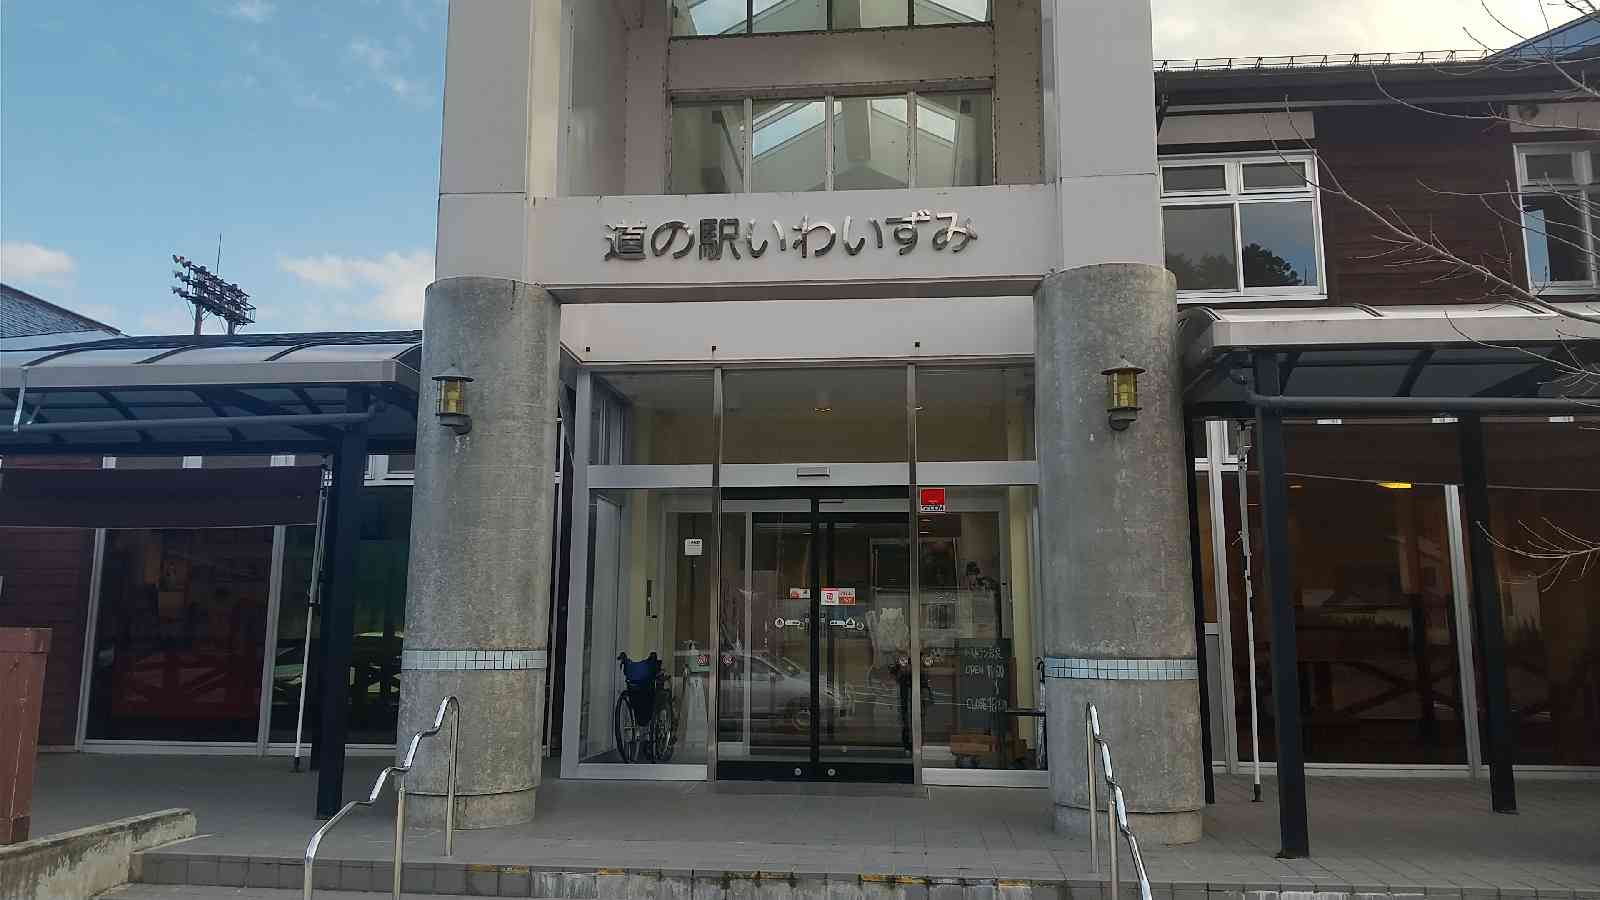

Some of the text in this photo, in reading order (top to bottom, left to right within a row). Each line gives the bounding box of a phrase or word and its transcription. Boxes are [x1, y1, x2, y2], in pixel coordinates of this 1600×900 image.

[604, 209, 978, 261] 道の駅いわいずみ
